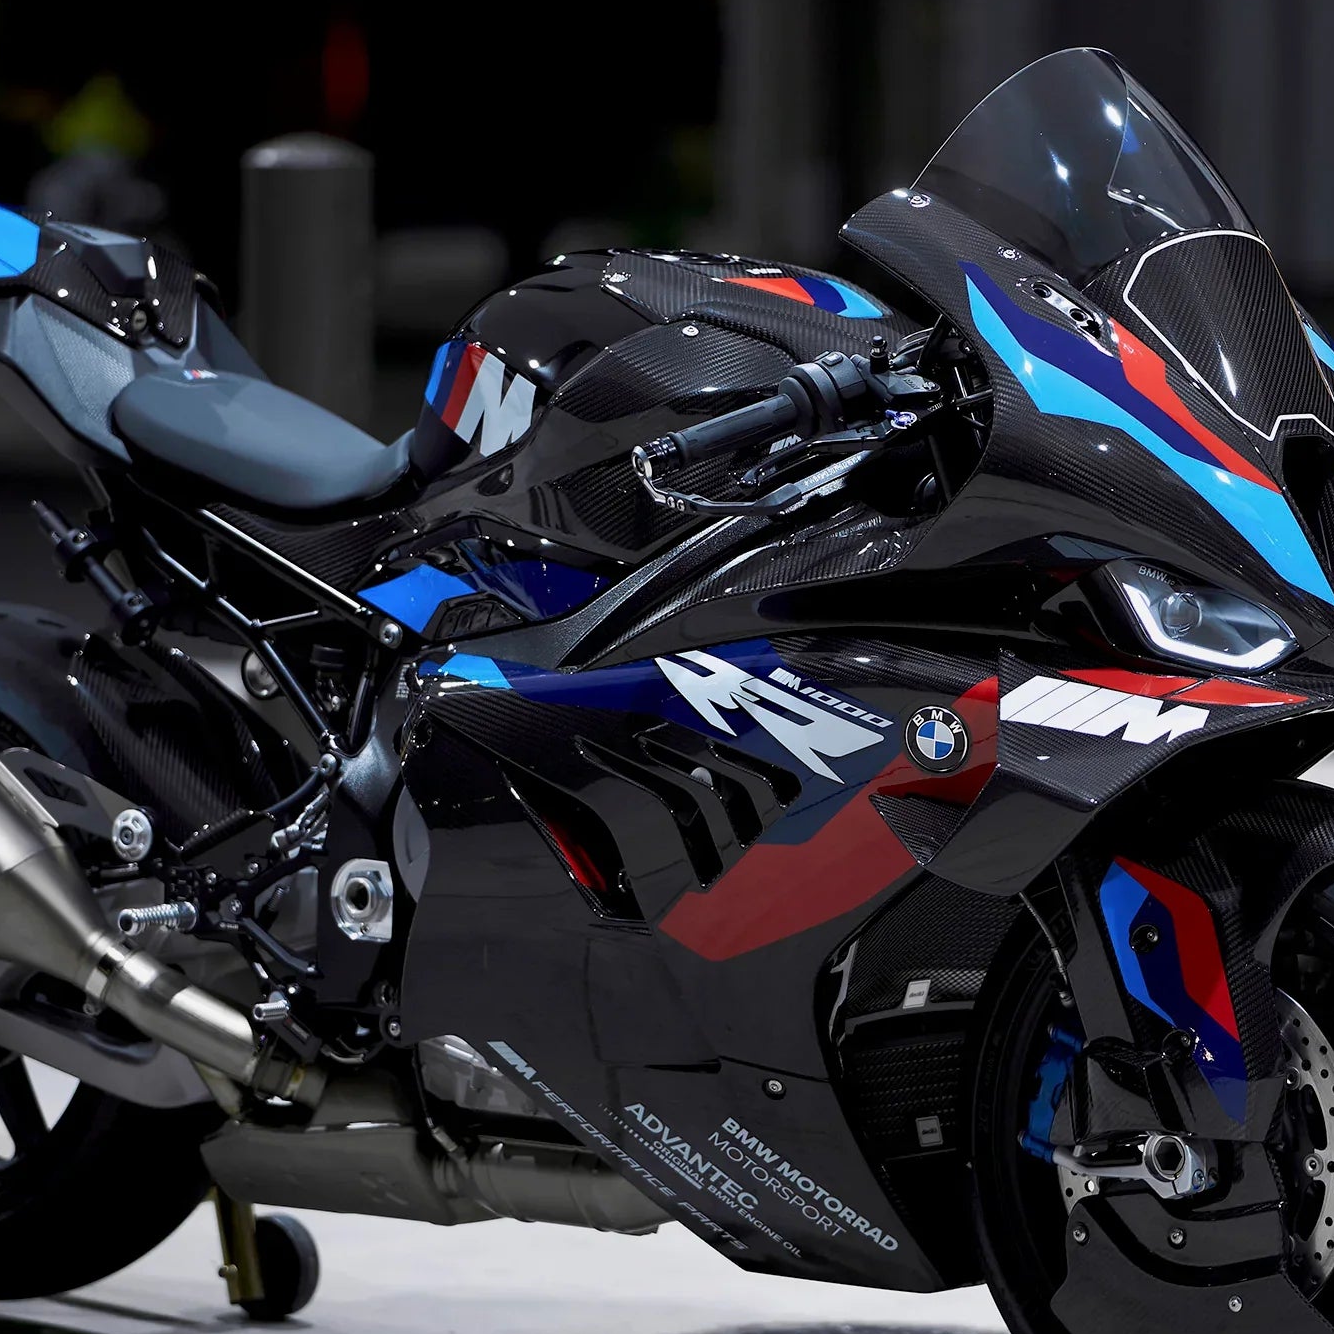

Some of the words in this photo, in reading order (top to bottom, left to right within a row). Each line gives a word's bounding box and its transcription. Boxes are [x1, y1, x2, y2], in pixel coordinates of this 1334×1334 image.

[532, 1081, 677, 1197] PERFORMANCE
[677, 1201, 750, 1250] PARTS
[624, 1103, 759, 1210] ADVANTEC
[653, 1140, 704, 1186] ORIGINAL
[707, 1184, 739, 1209] BMW
[737, 1207, 783, 1243] ENGINE
[782, 1241, 802, 1258] OIL
[708, 1131, 847, 1237] MOTORSPORT
[721, 1117, 780, 1164] BMW
[776, 1161, 899, 1251] MOTORRAD
